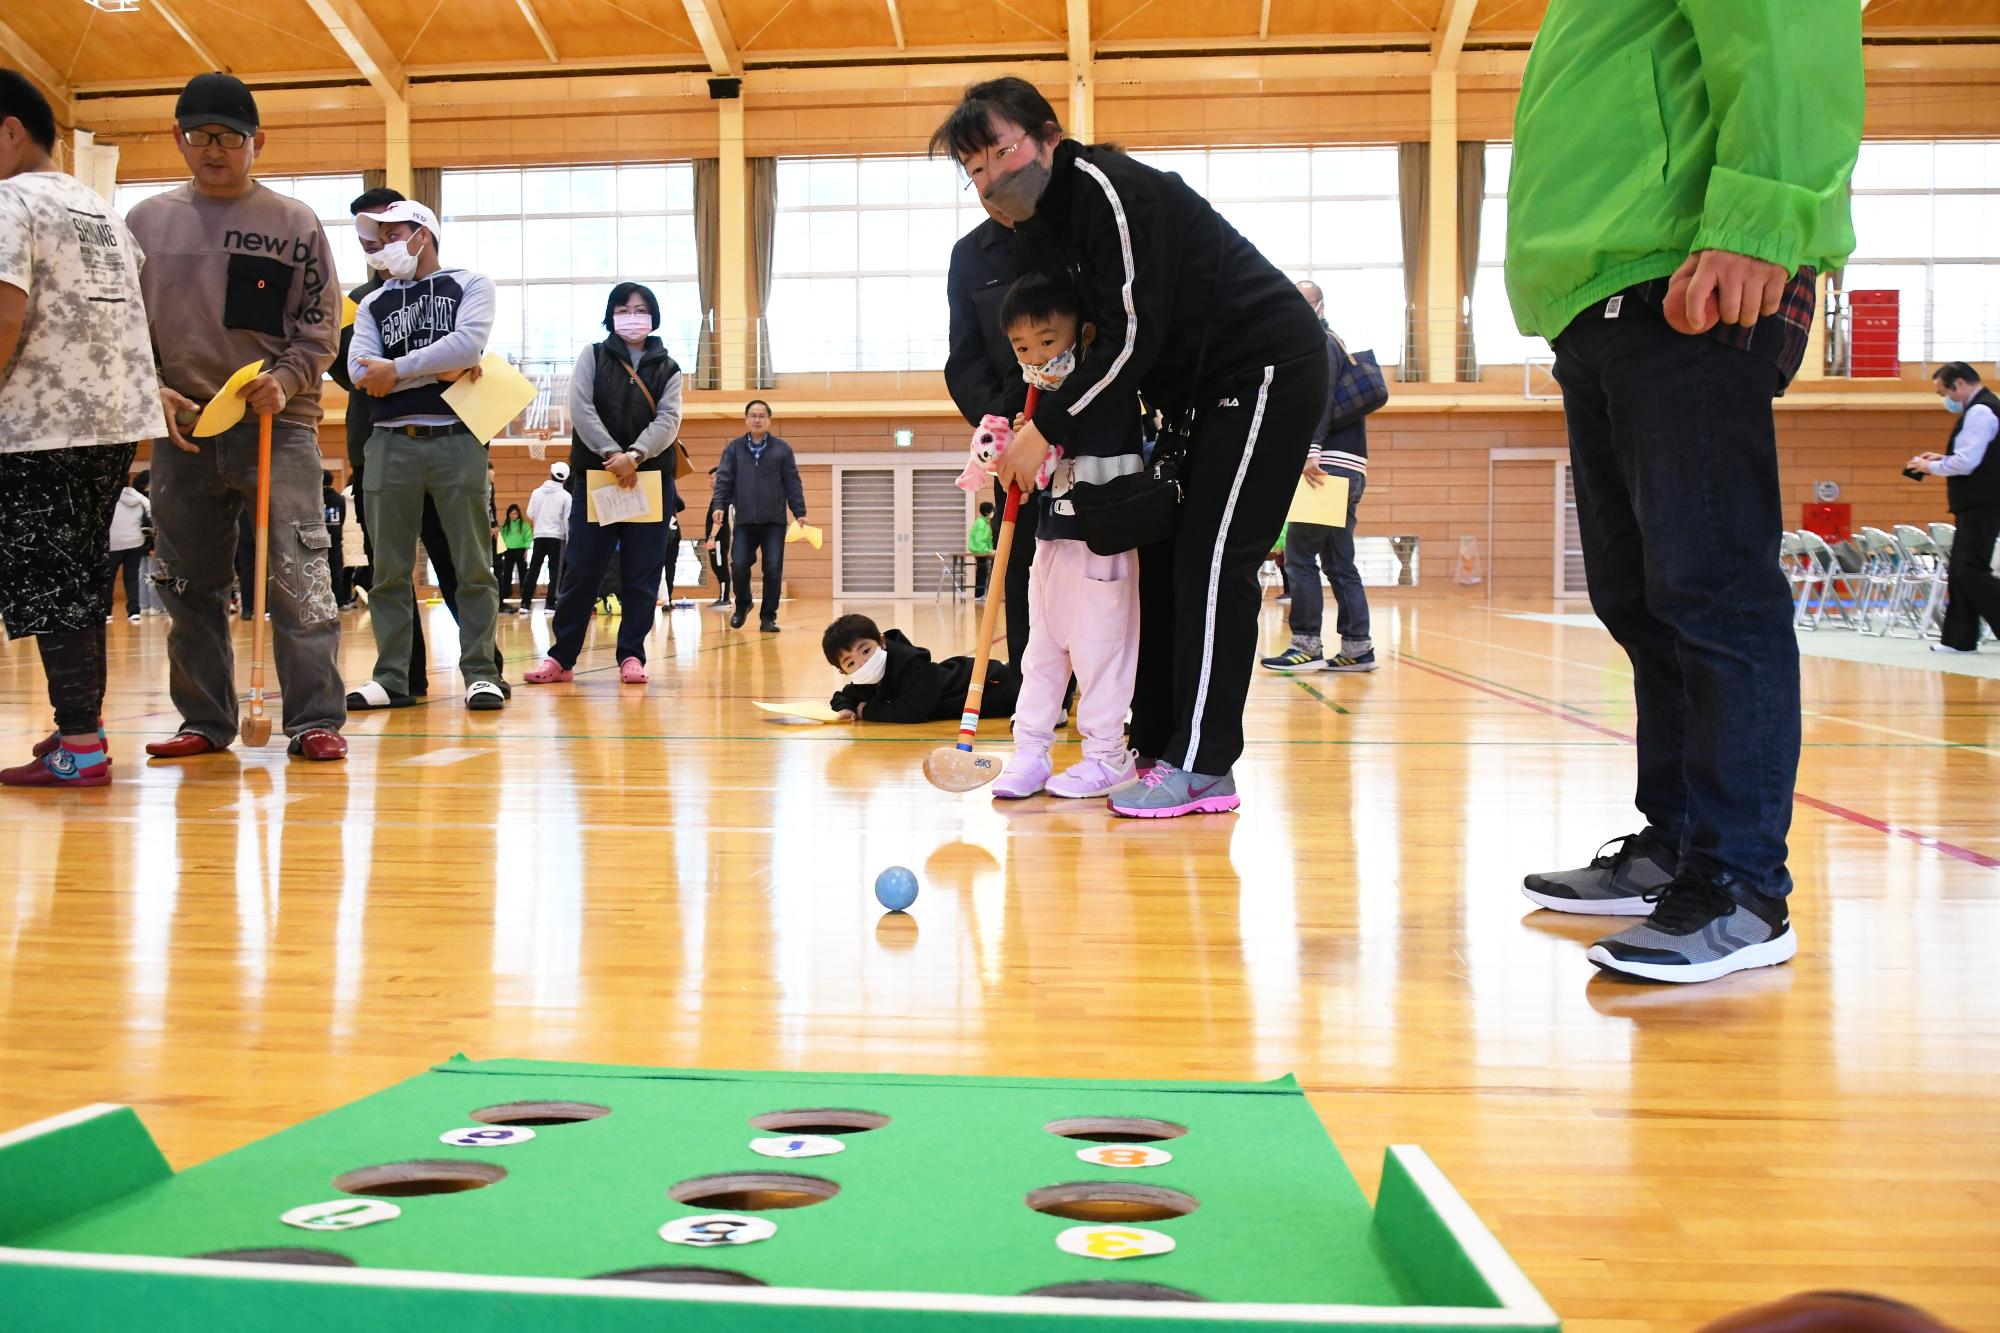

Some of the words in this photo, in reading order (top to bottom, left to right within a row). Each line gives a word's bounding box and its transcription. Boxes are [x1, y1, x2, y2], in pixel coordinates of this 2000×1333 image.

[223, 229, 289, 256] new
[1217, 397, 1240, 408] FILA
[1098, 1148, 1149, 1165] 8
[684, 1220, 748, 1243] 5
[1086, 1231, 1145, 1257] 3
